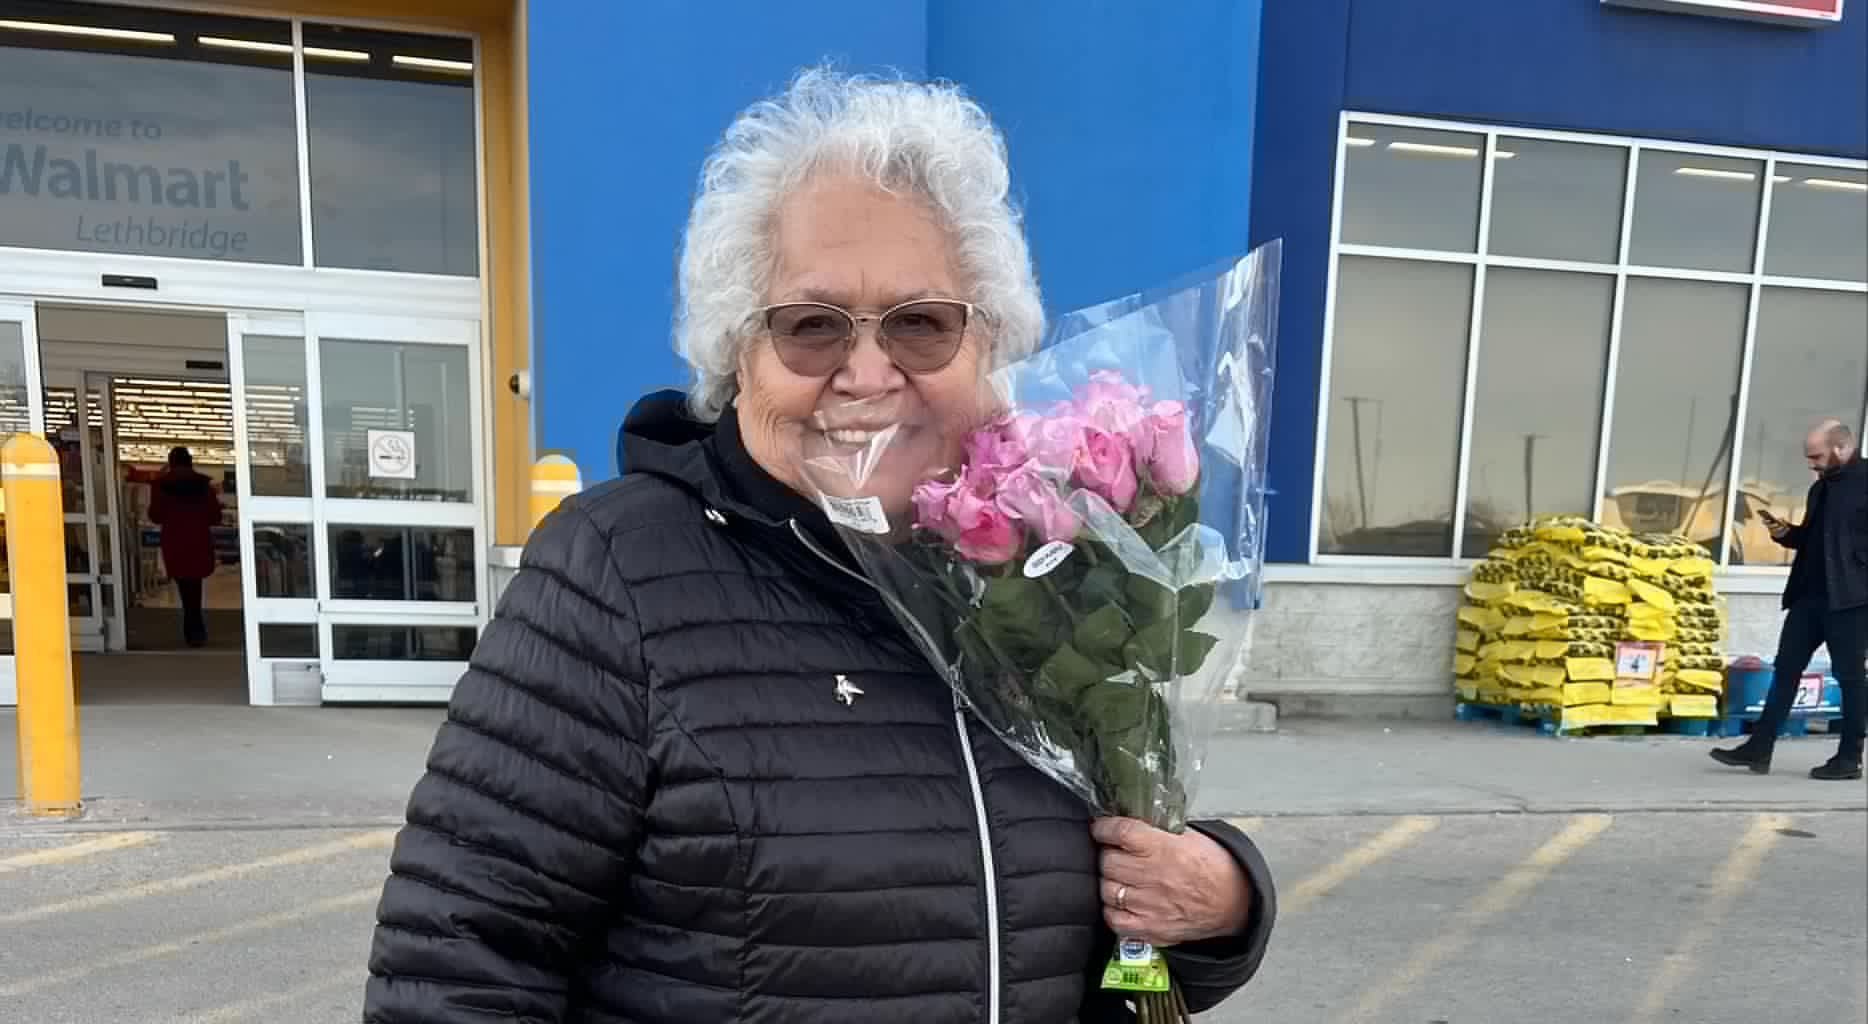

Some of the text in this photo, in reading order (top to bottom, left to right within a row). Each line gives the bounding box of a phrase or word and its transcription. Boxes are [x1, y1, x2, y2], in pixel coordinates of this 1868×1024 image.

[0, 105, 162, 140] elcome to
[0, 143, 249, 211] Walmart
[76, 215, 248, 257] Lethbridge
